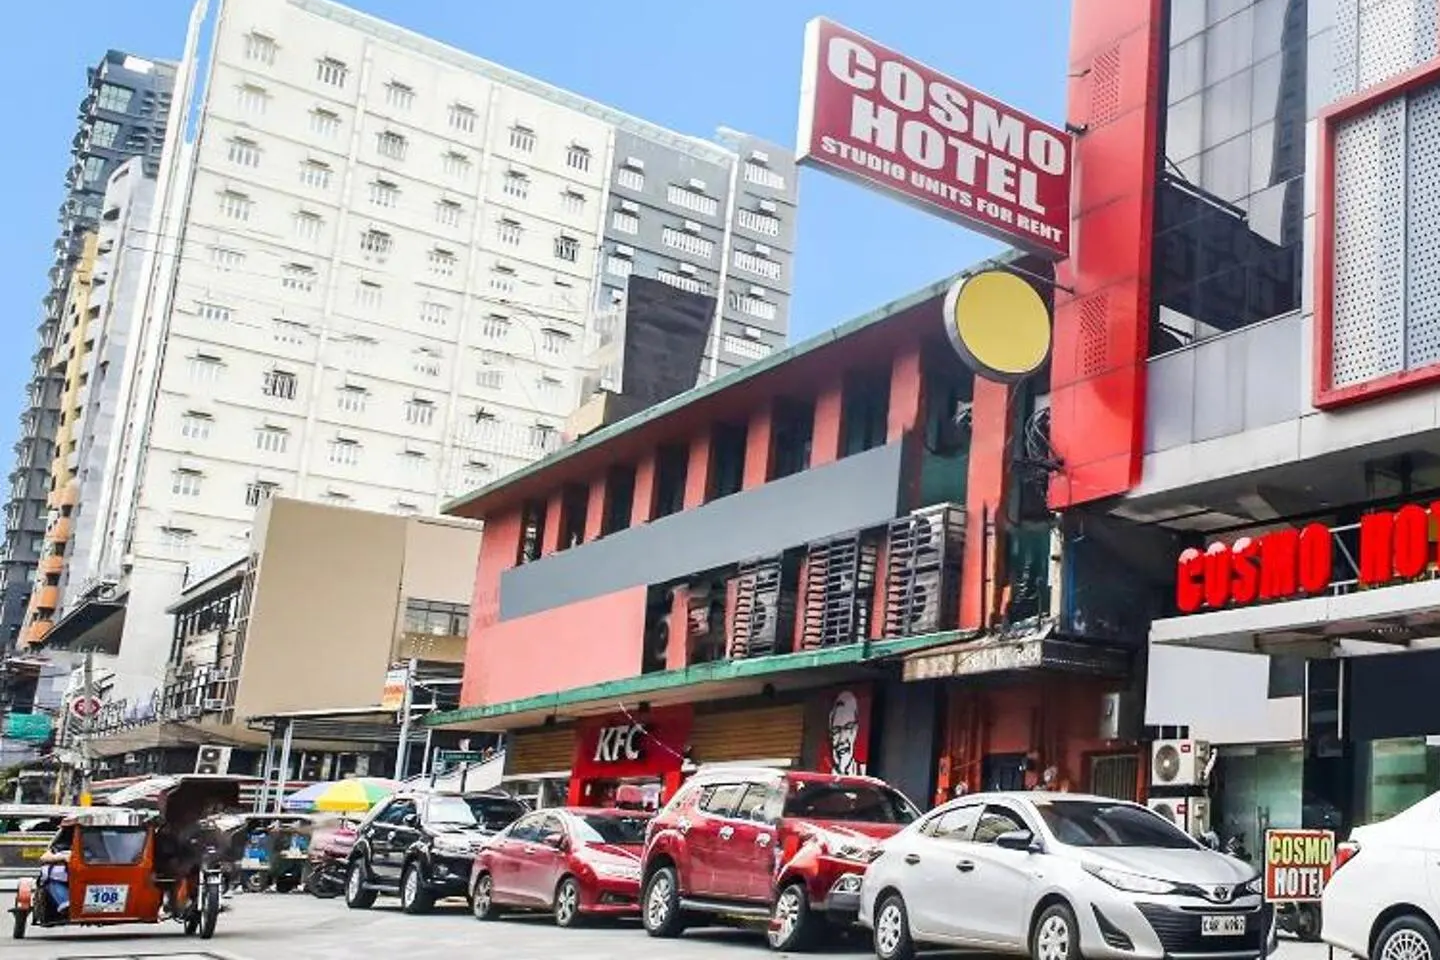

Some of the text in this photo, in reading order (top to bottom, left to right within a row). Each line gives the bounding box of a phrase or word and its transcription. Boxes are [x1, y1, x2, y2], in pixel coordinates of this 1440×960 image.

[827, 38, 1066, 176] COSMO
[820, 135, 1063, 243] STUDIO UNITS FOR RENT
[851, 94, 1046, 215] HOTEL
[1176, 521, 1333, 614] COSMO
[593, 724, 645, 761] KFC
[1269, 836, 1332, 865] COSMO
[92, 892, 119, 904] 108
